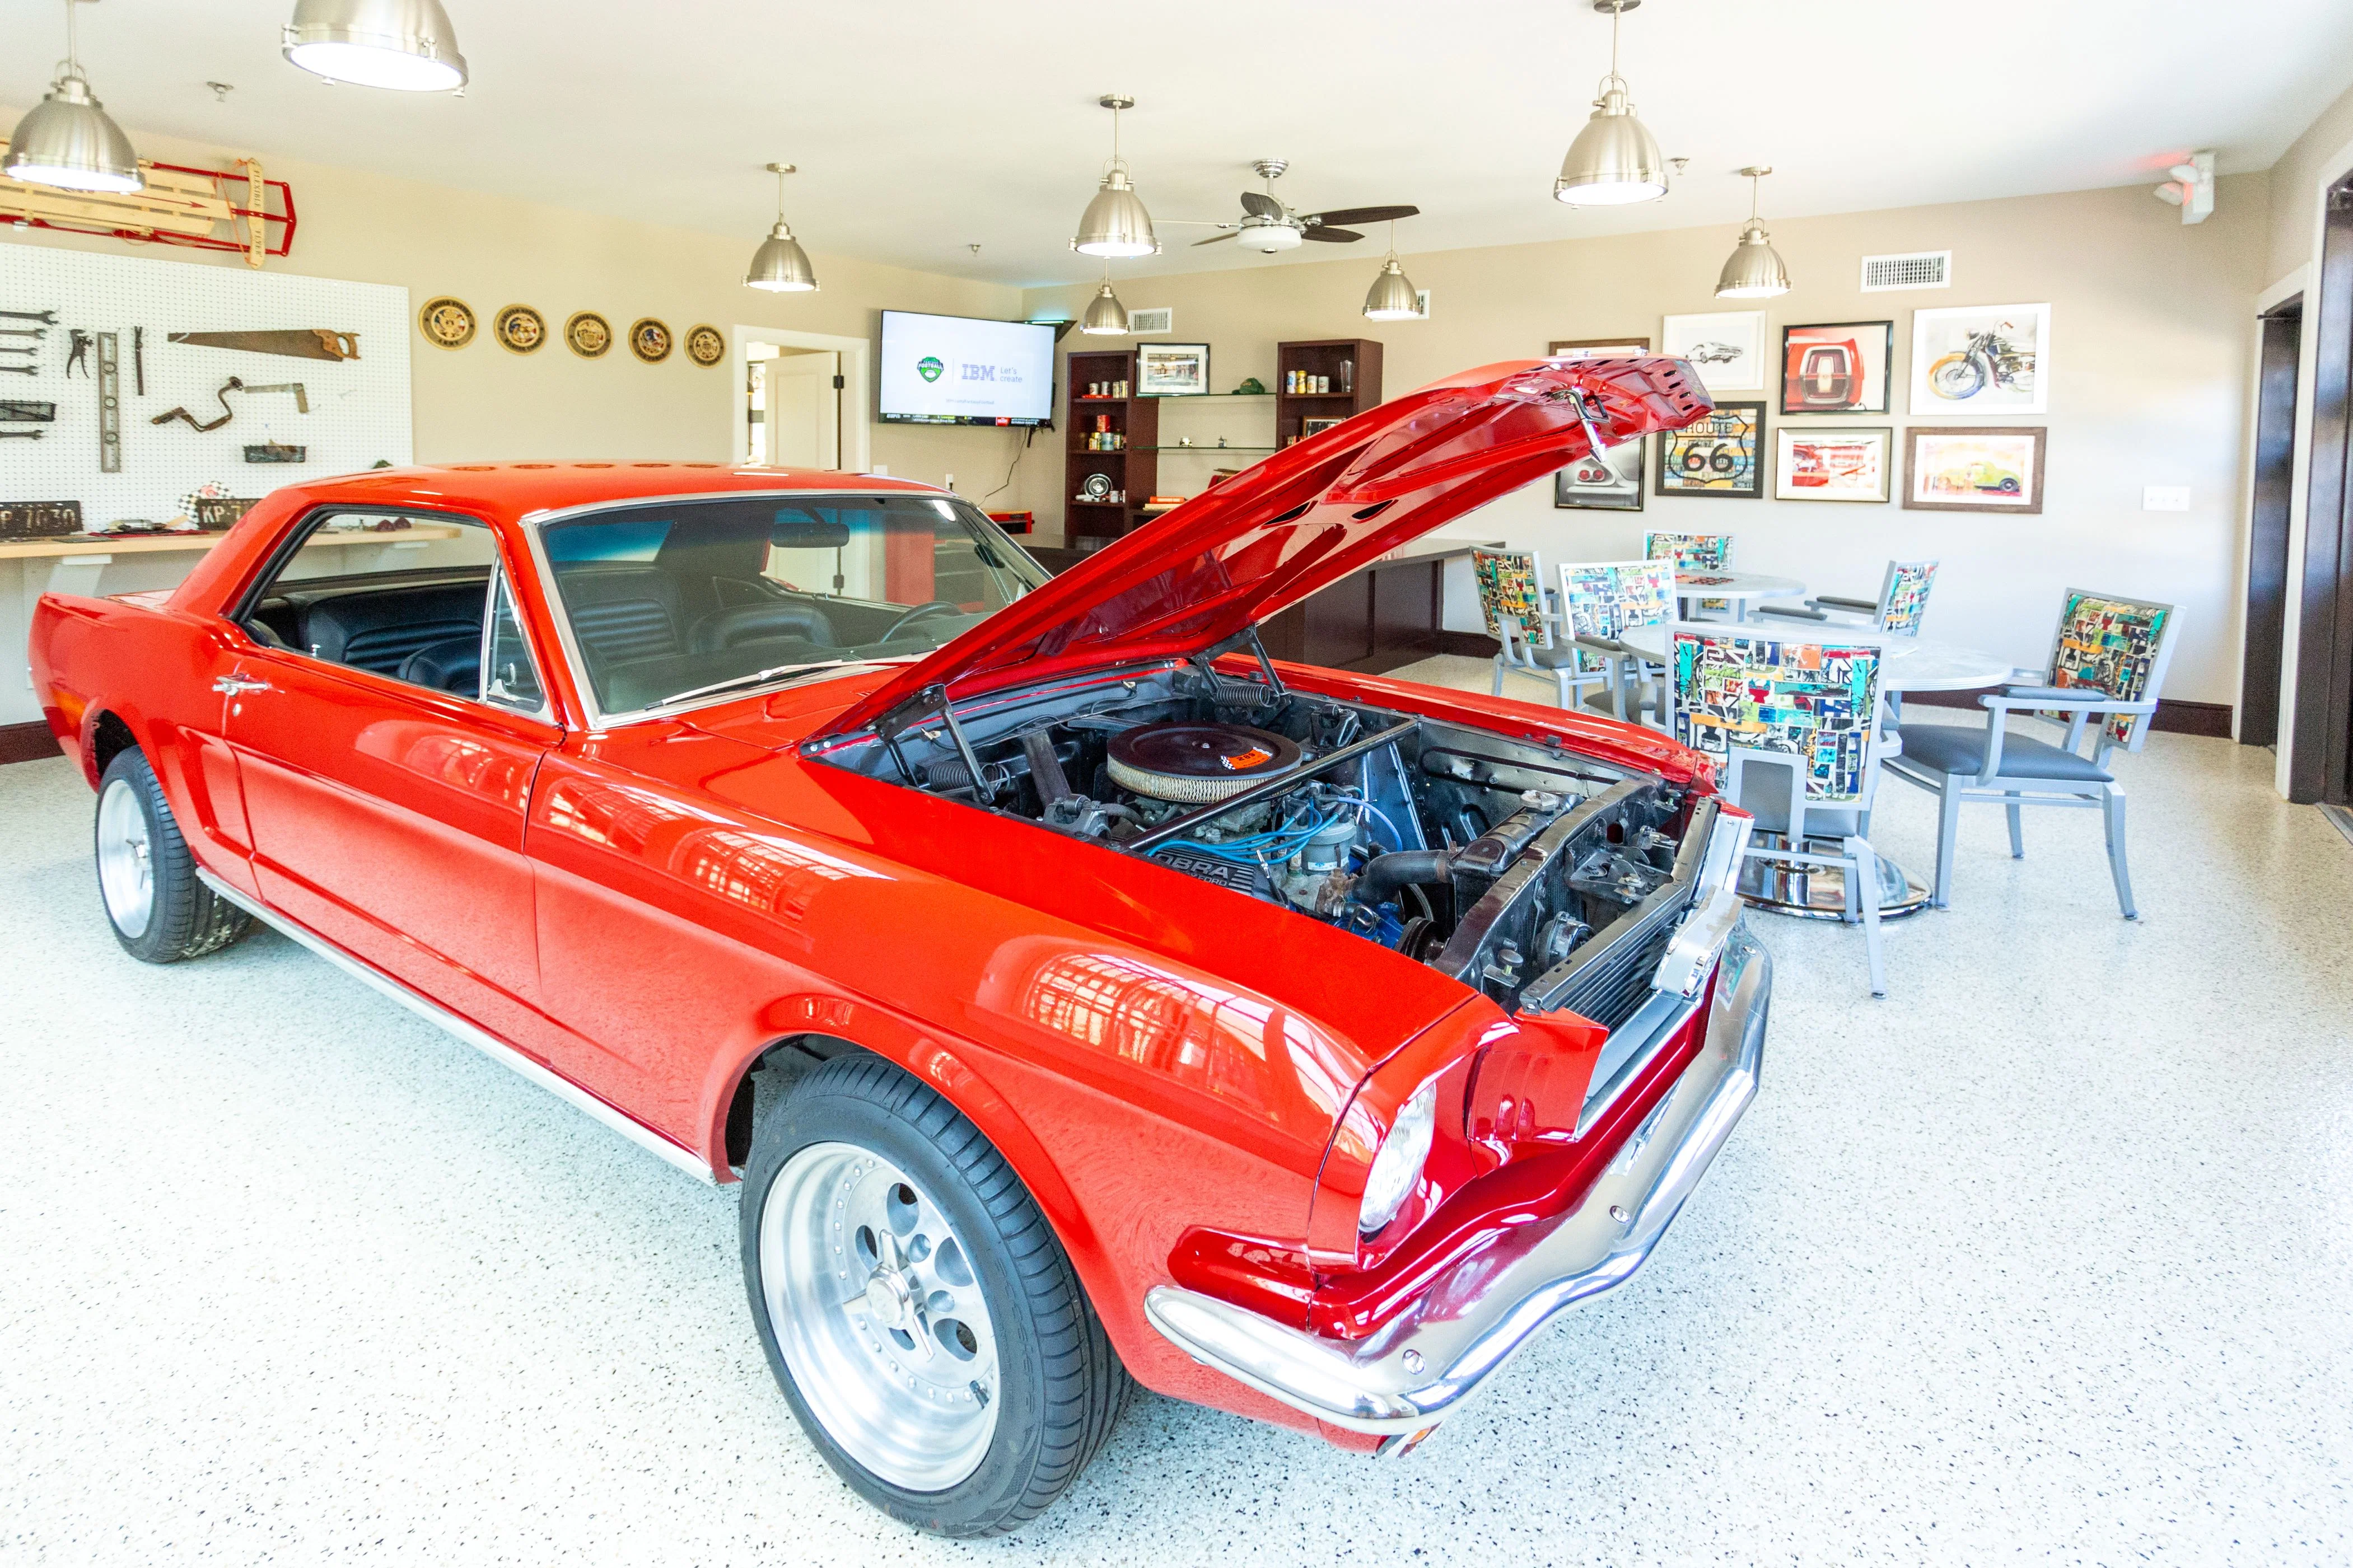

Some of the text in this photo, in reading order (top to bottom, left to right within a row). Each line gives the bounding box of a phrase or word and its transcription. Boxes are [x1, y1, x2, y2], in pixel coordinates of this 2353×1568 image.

[961, 364, 995, 381] IBM
[1686, 422, 1733, 434] ROUTE
[1683, 443, 1734, 472] 66
[1236, 752, 1255, 761] 289
[1154, 853, 1229, 879] OBRA
